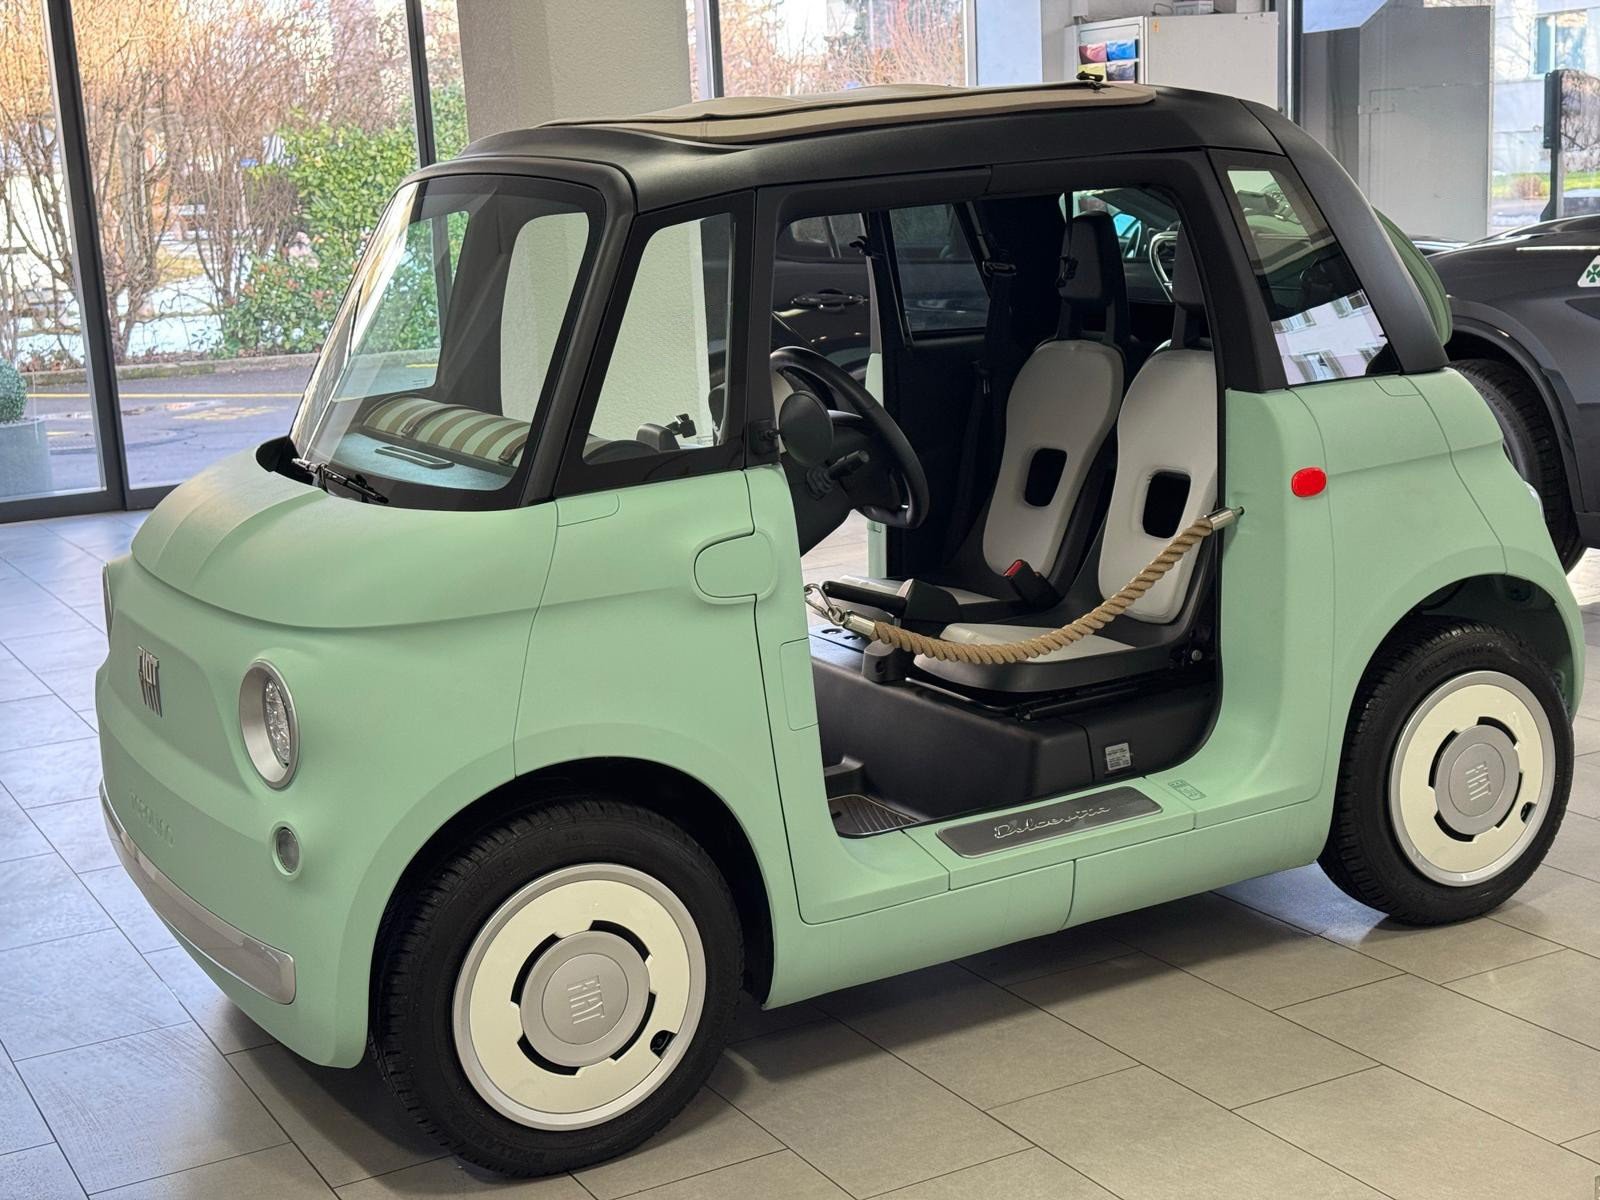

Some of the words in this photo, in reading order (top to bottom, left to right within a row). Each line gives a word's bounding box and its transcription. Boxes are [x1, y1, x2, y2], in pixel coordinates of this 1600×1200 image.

[1465, 761, 1491, 801] FIAT
[994, 807, 1111, 839] Dolcevita
[567, 976, 605, 1024] FIAT
